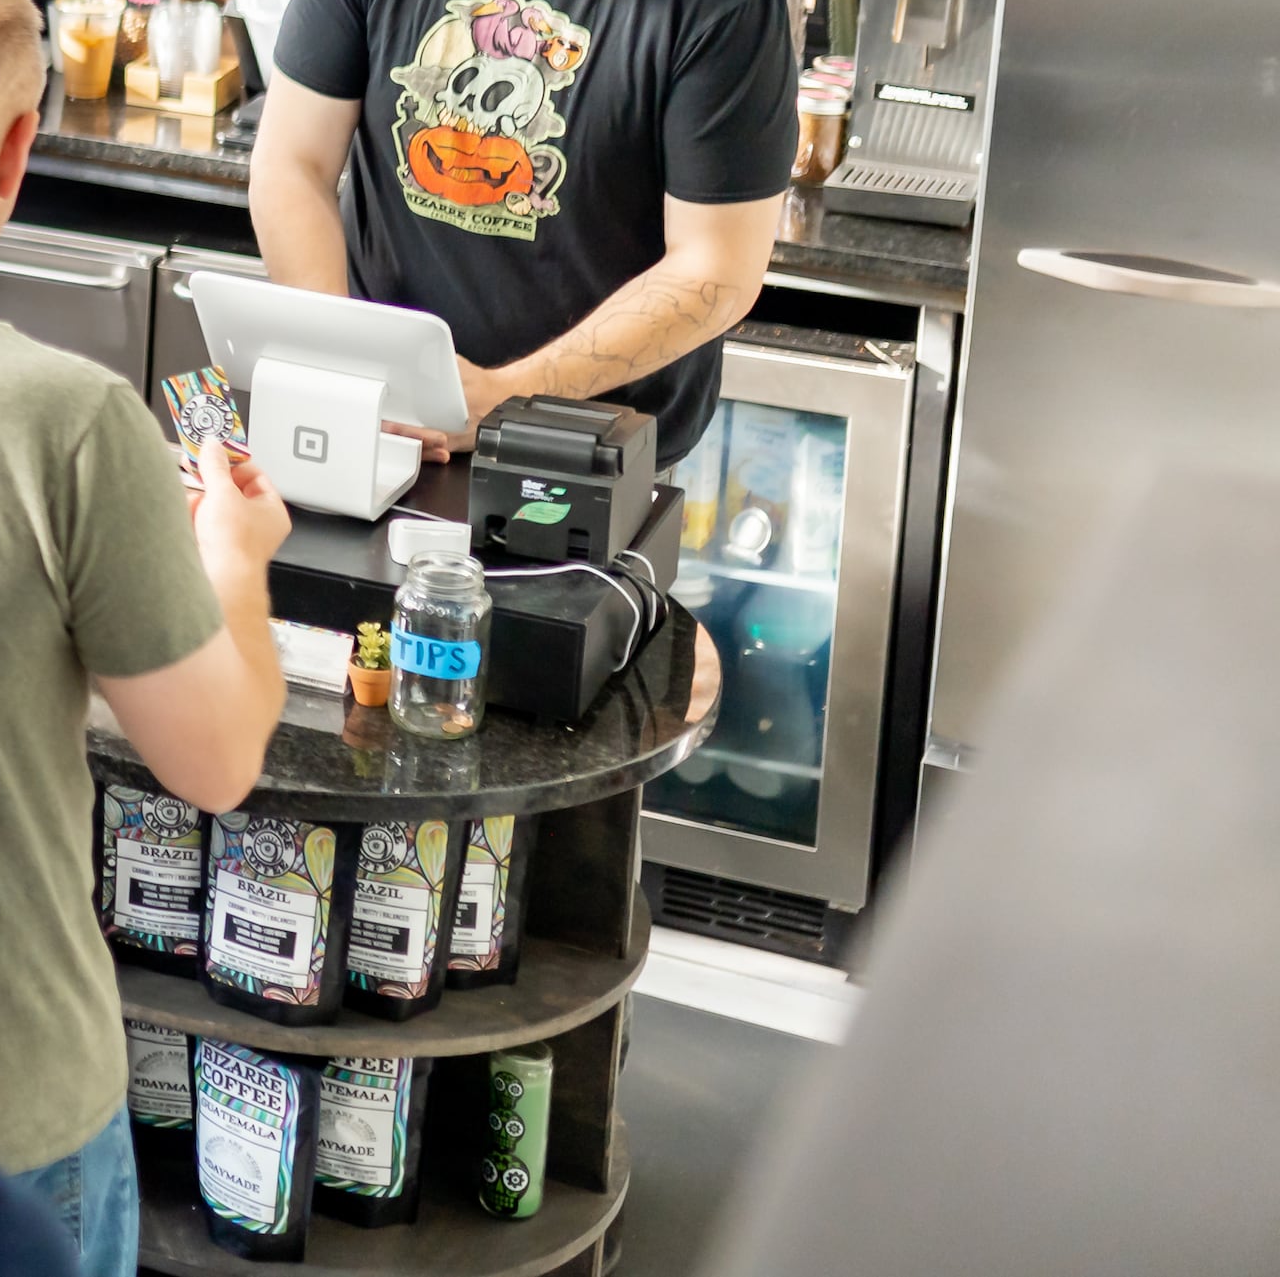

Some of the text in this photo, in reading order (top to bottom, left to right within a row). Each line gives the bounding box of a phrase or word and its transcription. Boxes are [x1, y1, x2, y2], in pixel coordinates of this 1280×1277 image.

[472, 213, 533, 232] COFFEE
[395, 633, 467, 674] TIPS
[145, 812, 194, 838] COFFEE
[140, 845, 199, 862] BRAZIL
[244, 845, 290, 875] COFFEE
[237, 878, 291, 904] BRAZIL
[357, 882, 404, 900] RAZIL
[129, 1020, 186, 1036] GUATEM
[203, 1043, 282, 1096] BIZARRE
[135, 1078, 188, 1093] #DAYMA
[202, 1062, 281, 1113] COFFEE
[200, 1097, 277, 1141] GUATEMALA
[319, 1138, 376, 1157] AYMADE
